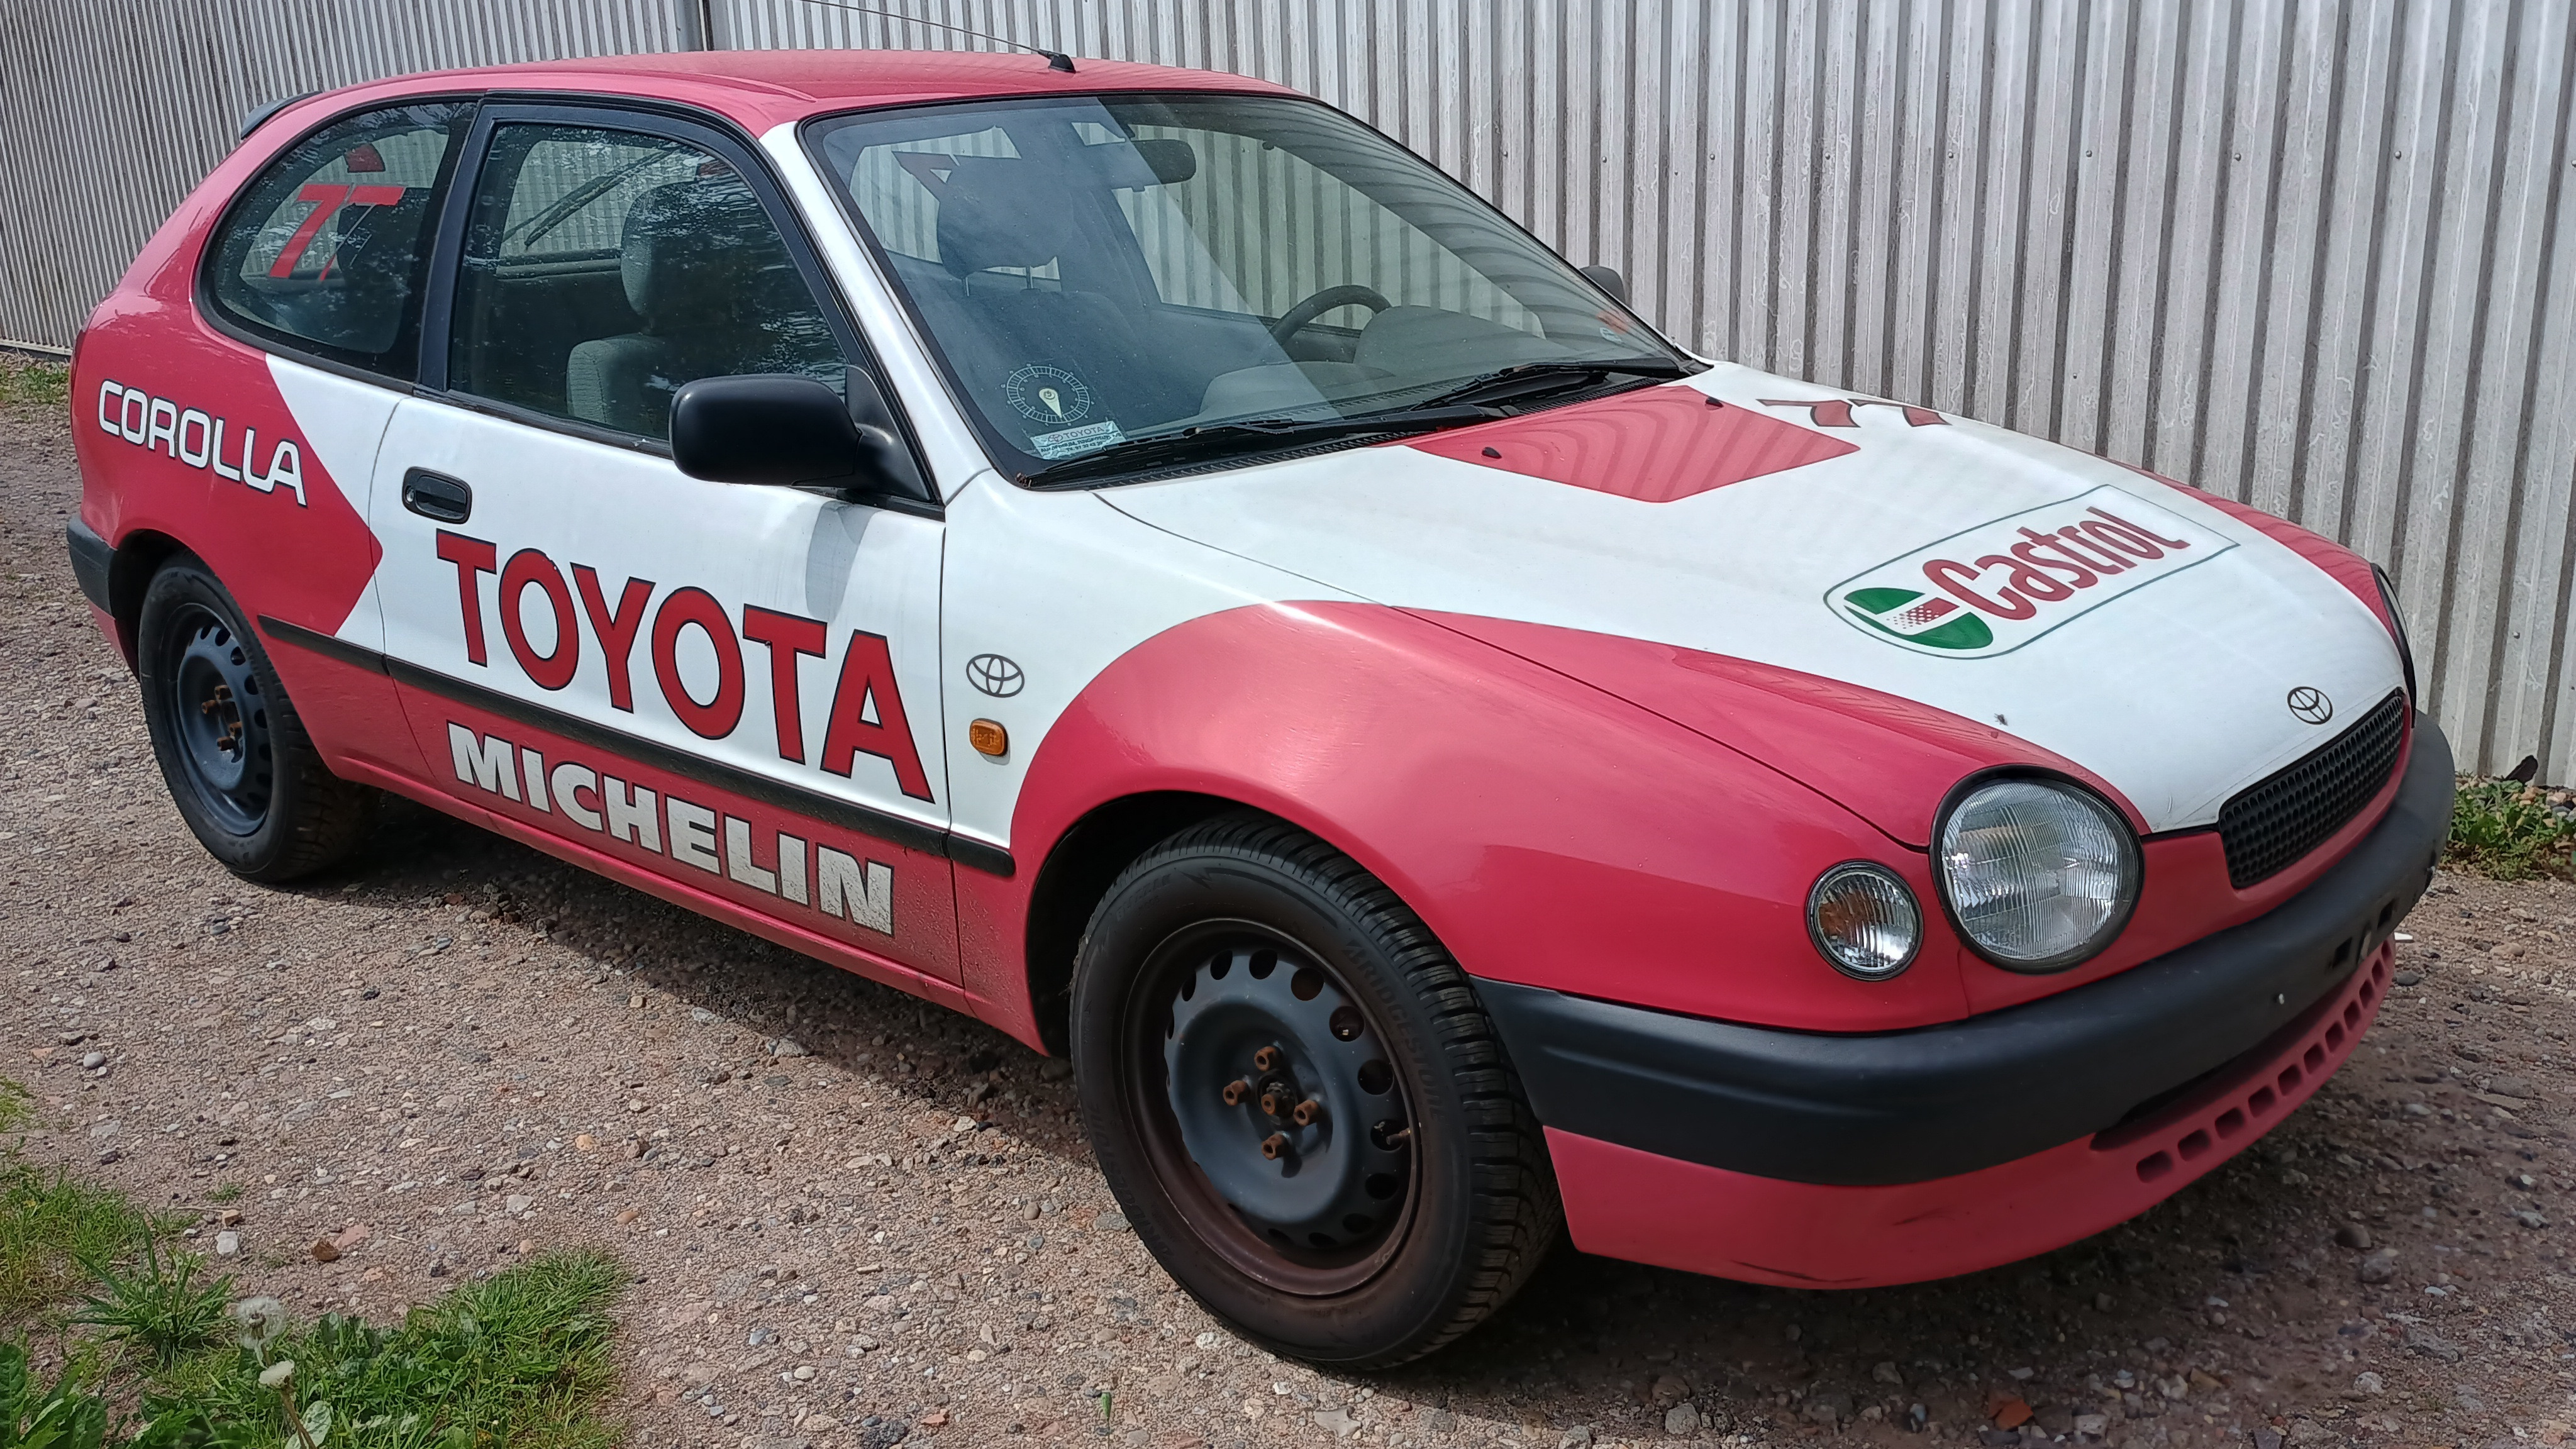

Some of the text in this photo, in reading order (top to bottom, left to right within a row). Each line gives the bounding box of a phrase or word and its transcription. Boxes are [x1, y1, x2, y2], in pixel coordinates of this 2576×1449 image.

[99, 379, 307, 506] COROLLA
[1063, 426, 1105, 439] TOYOTA
[1923, 506, 2190, 620] Castrol
[436, 529, 935, 803] TOYOTA
[447, 720, 894, 937] MICHELIN
[1341, 938, 1446, 1120] BRIDGESTONE
